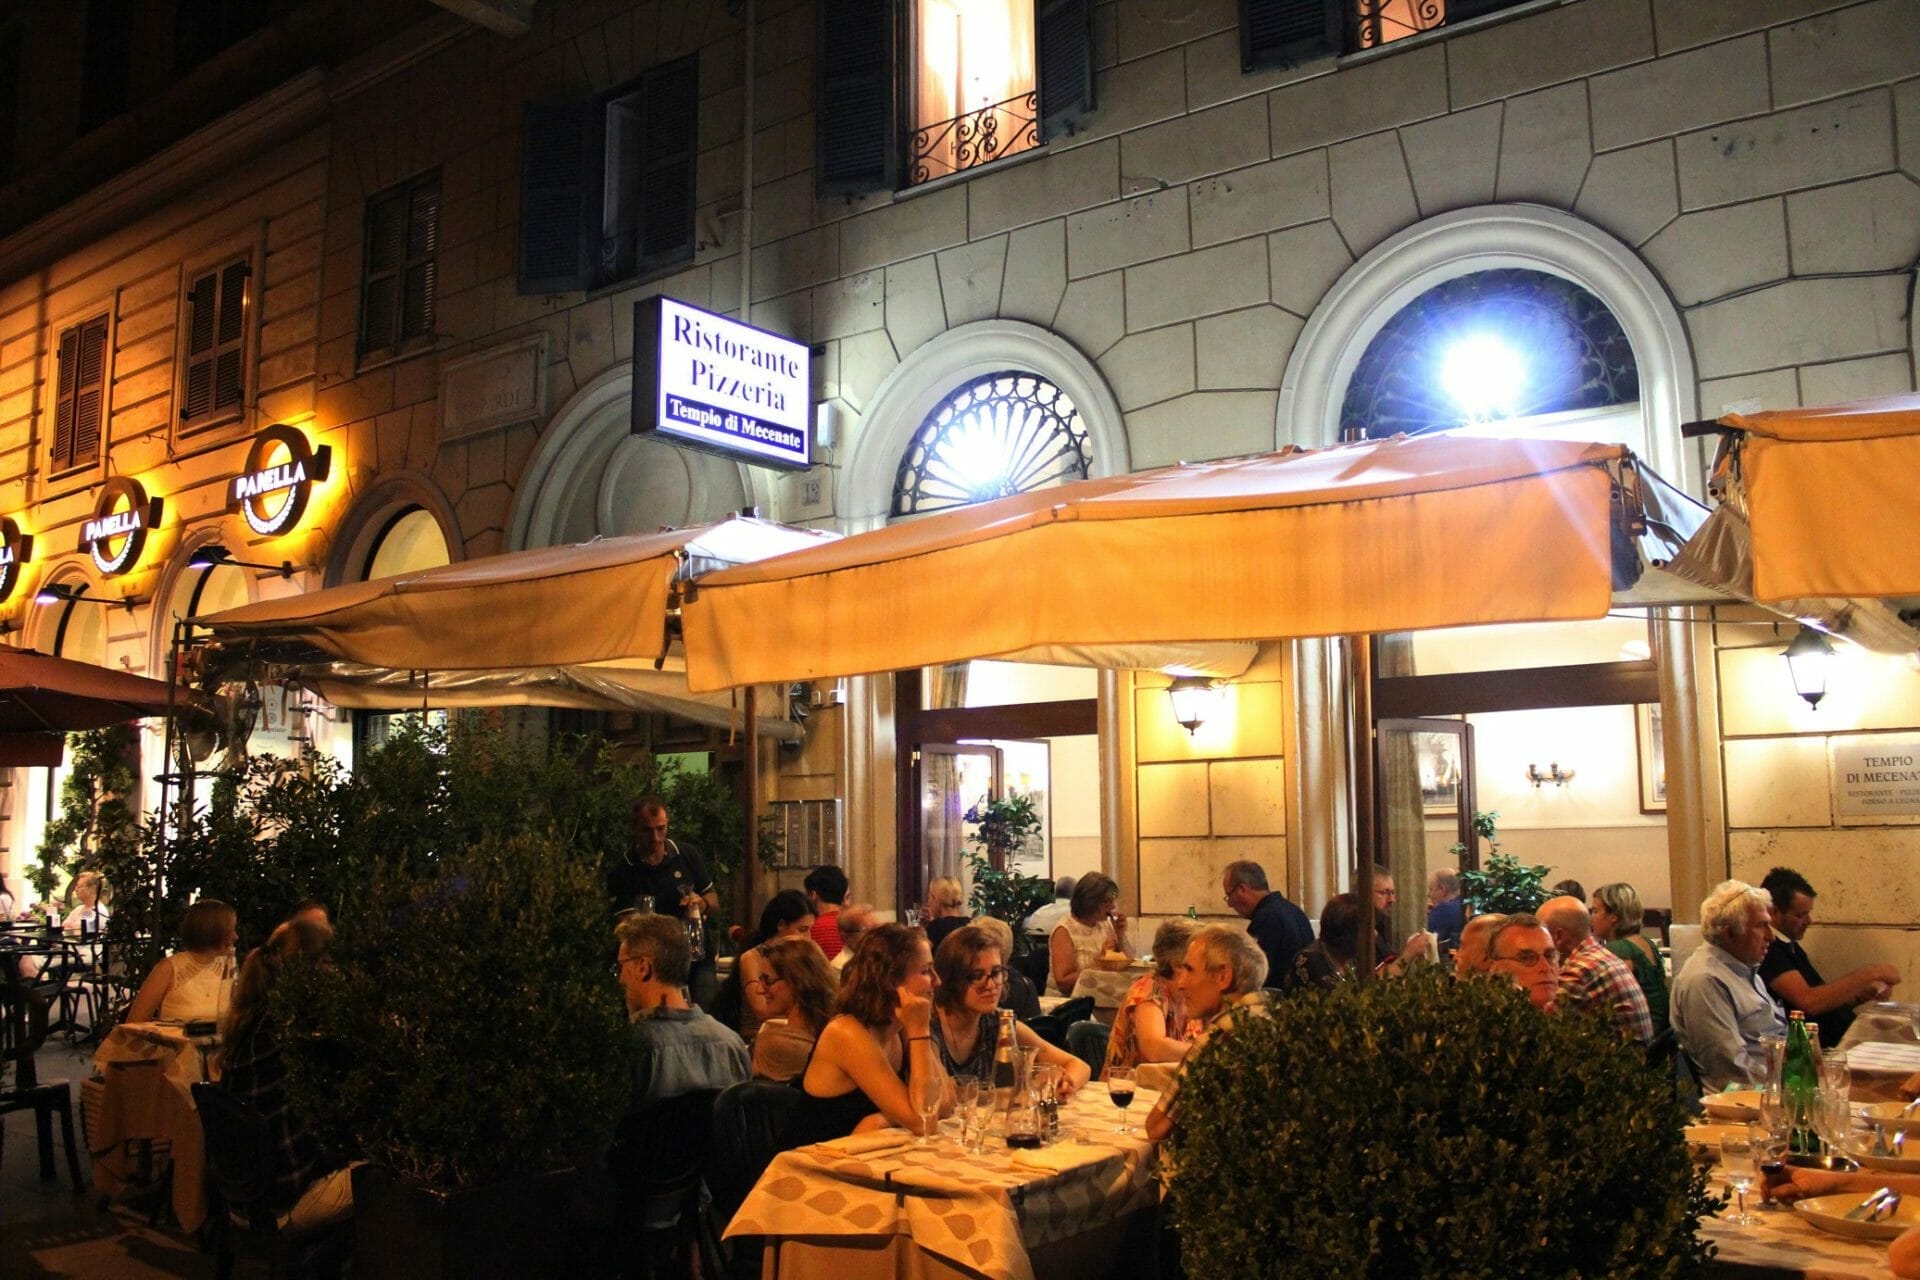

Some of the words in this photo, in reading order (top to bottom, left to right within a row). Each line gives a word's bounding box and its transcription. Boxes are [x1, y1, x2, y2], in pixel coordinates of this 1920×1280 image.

[674, 314, 799, 379] Ristorante
[691, 358, 785, 412] Pizzeria
[670, 399, 722, 428] Tempio
[725, 413, 738, 432] di
[741, 417, 801, 449] Mecenate
[236, 461, 306, 499] PANELLA
[86, 510, 141, 541] PANELLA
[1847, 773, 1859, 783] DI
[1863, 756, 1913, 767] TEMPIO
